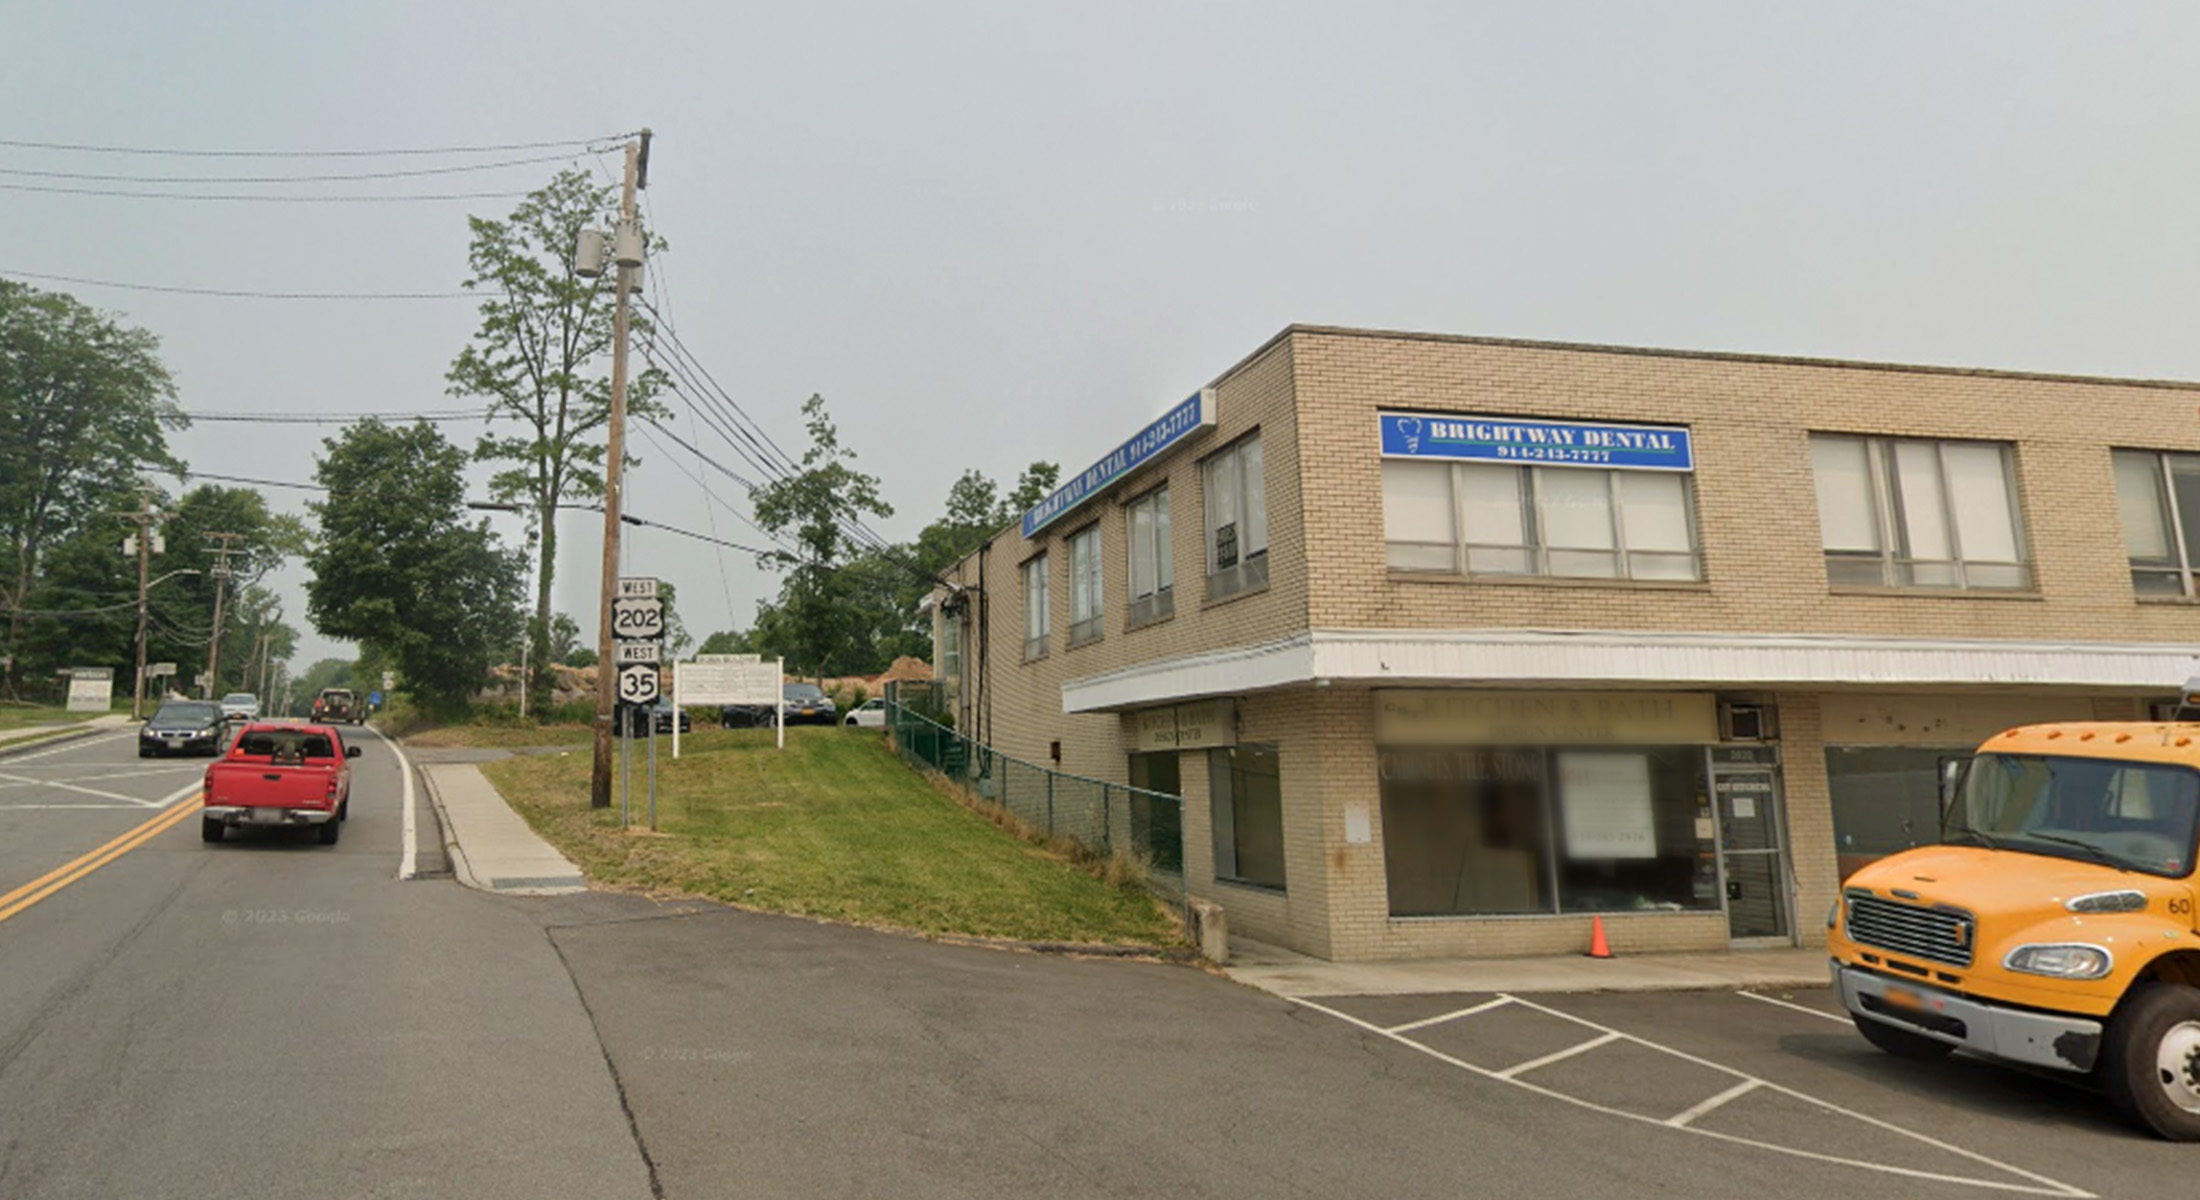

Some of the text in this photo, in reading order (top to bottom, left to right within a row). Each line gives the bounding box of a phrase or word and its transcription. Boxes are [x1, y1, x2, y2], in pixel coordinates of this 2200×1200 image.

[1429, 421, 1676, 450] BRIGHTWAY DENTAL
[1497, 446, 1610, 463] 914-243-7777
[622, 582, 653, 594] WEST
[619, 608, 658, 628] 202
[623, 647, 654, 659] WEST
[623, 673, 655, 696] 35
[1423, 697, 1554, 719] KITCHEN
[1599, 698, 1674, 720] BATH
[1551, 726, 1616, 740] CENTER
[2168, 898, 2191, 915] 60
